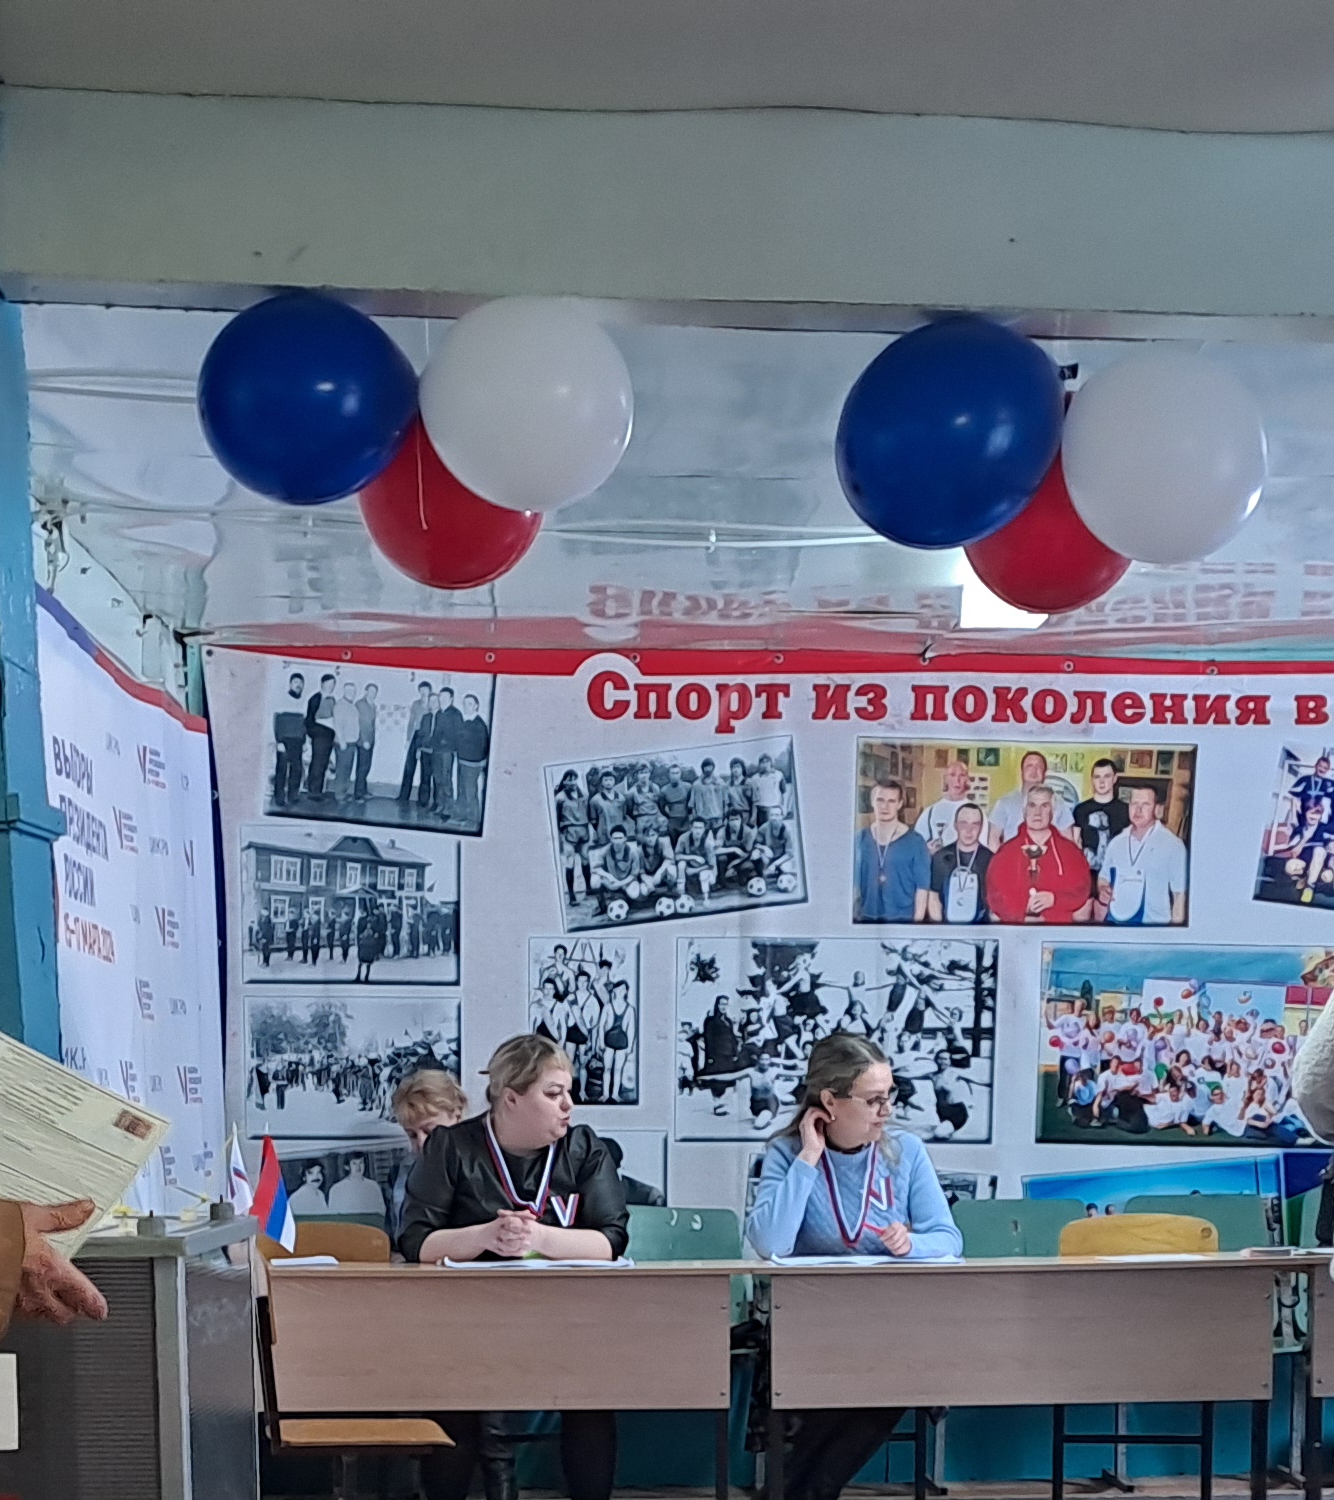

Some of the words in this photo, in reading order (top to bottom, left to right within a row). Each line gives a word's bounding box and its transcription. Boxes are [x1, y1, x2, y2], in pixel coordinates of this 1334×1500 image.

[587, 668, 791, 734] Спорт
[811, 682, 889, 722] из
[908, 684, 1272, 727] поколения
[1293, 692, 1331, 727] в
